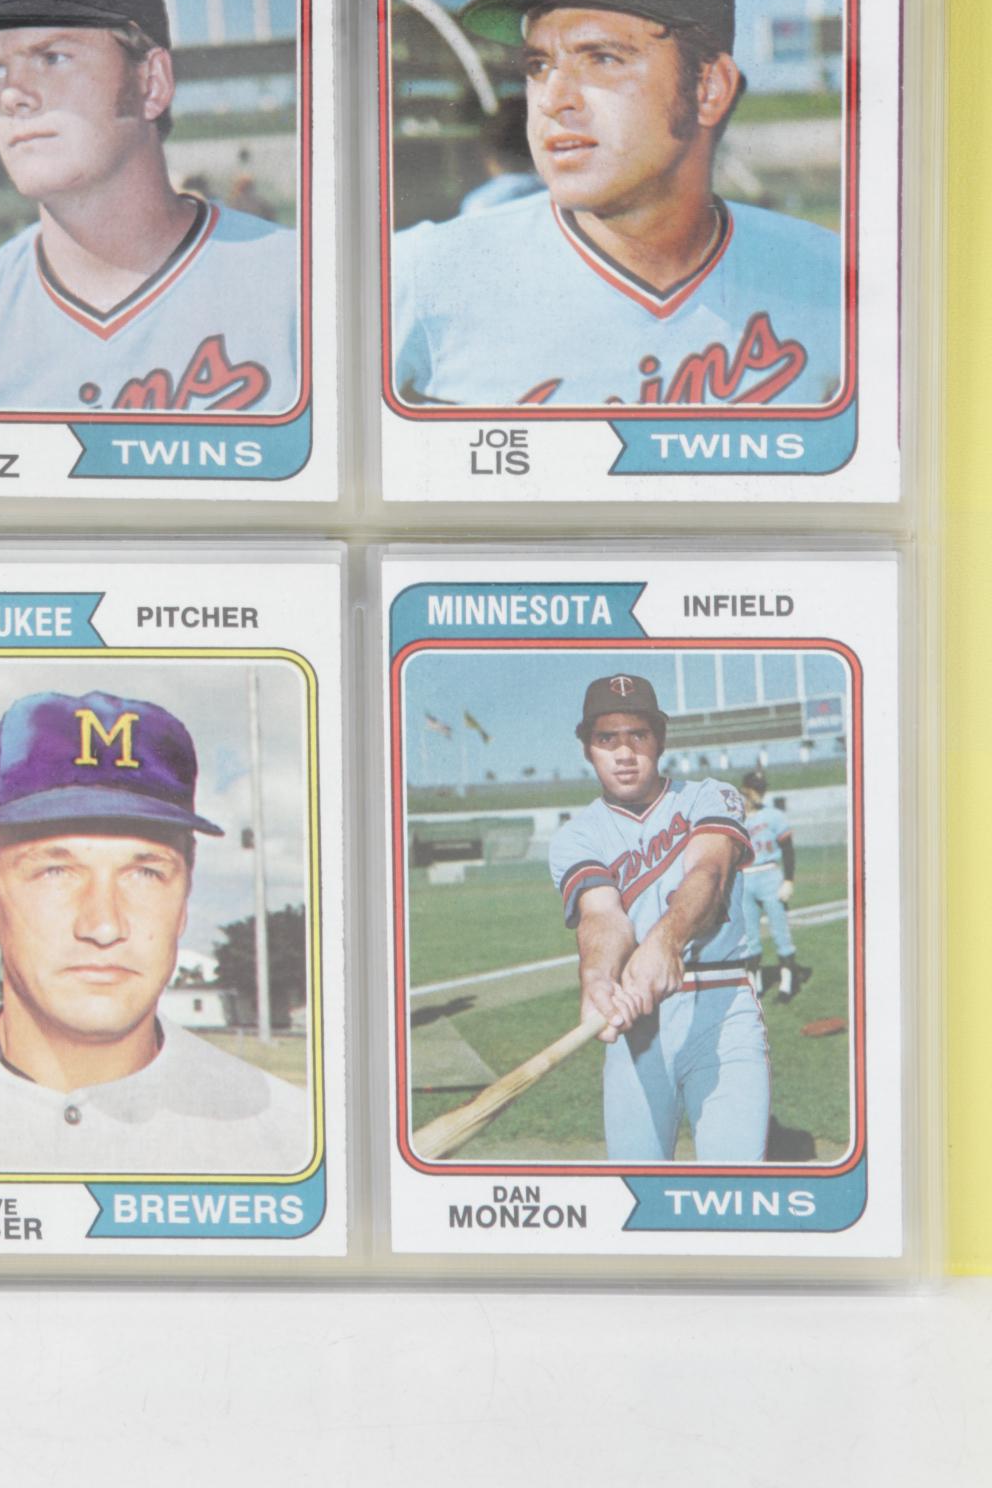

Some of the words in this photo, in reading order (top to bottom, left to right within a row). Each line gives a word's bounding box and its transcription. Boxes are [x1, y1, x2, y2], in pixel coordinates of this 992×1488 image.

[469, 428, 529, 449] JOE
[650, 433, 805, 460] TWINS
[111, 439, 263, 467] TWINS
[470, 450, 531, 476] LIS
[136, 606, 259, 629] PITCHER
[427, 594, 612, 626] MINNESOTA
[683, 594, 795, 617] INFIELD
[73, 708, 140, 769] M
[492, 1185, 541, 1204] DAN
[664, 1189, 816, 1217] TWINS
[113, 1193, 304, 1225] BREWERS
[448, 1204, 587, 1229] MONZON
